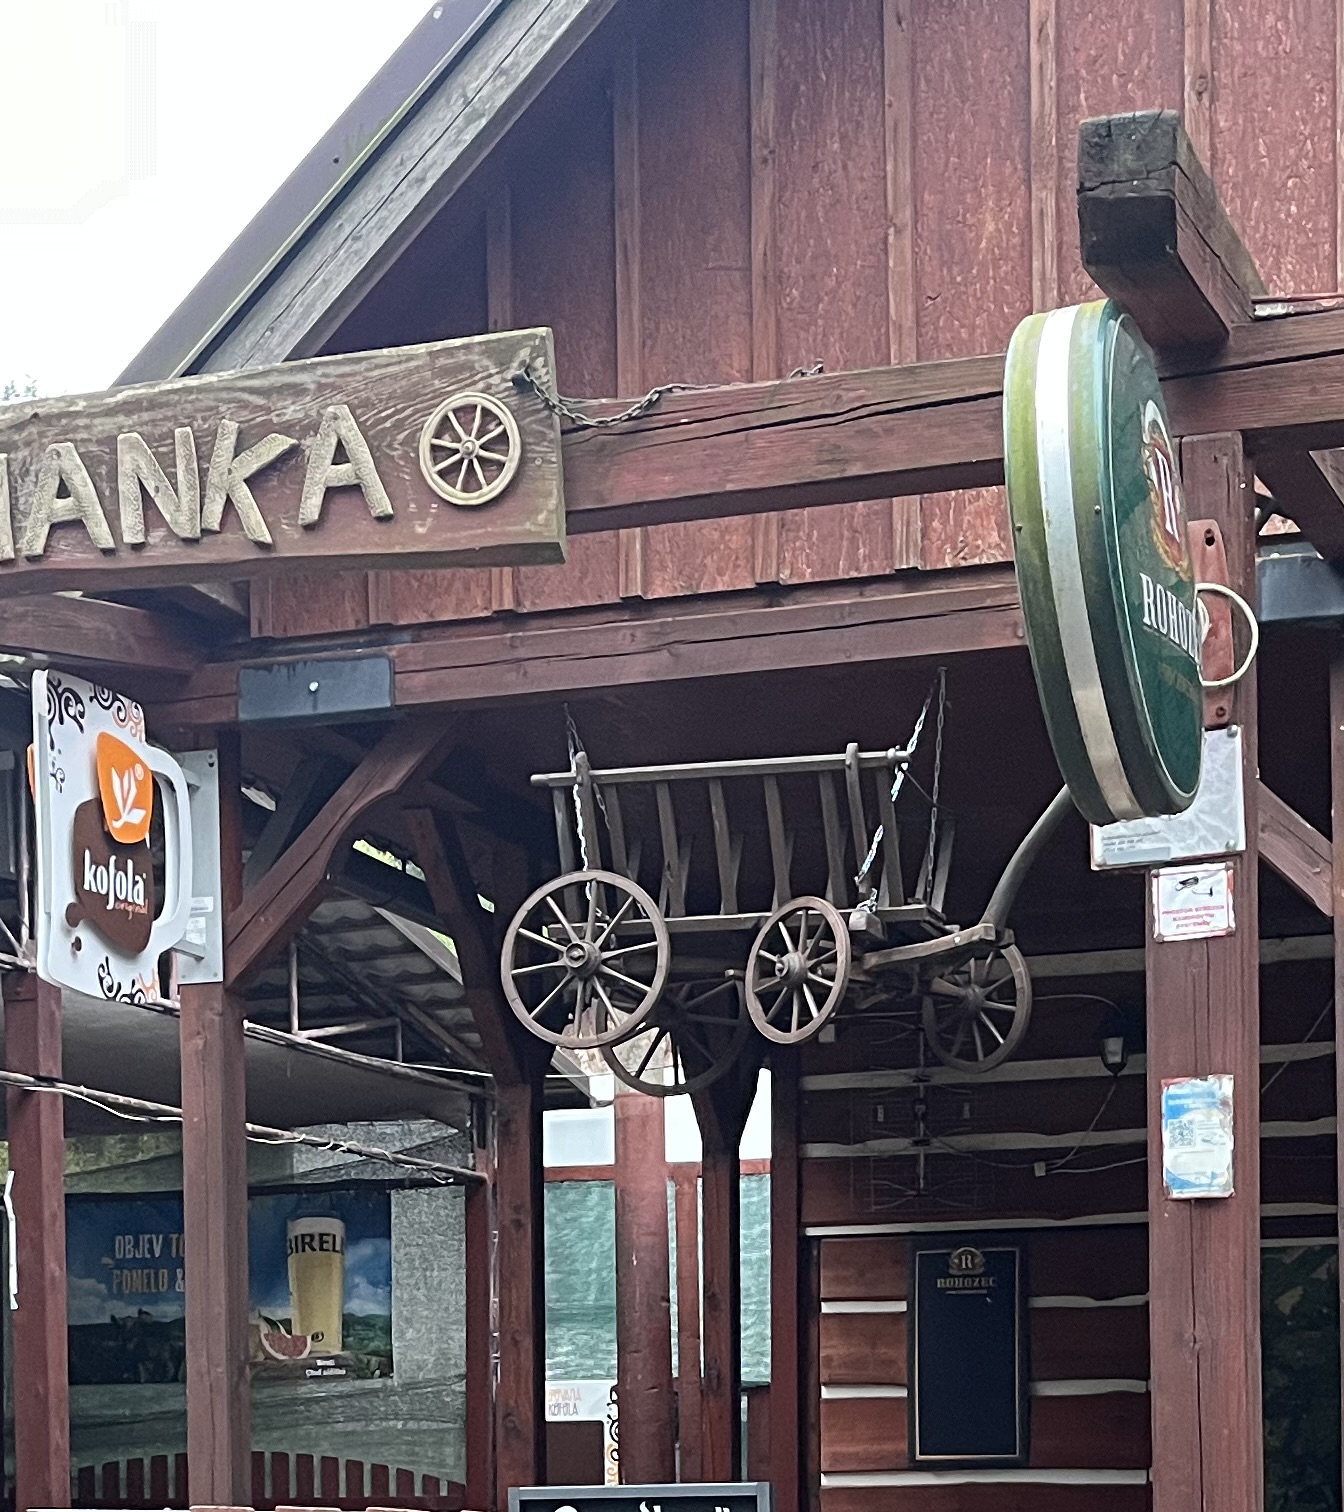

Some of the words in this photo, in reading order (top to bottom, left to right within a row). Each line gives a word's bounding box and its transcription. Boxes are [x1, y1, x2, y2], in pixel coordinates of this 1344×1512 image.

[83, 848, 144, 911] kofola
[115, 1234, 163, 1259] OBJEV
[113, 1268, 168, 1294] POMELO
